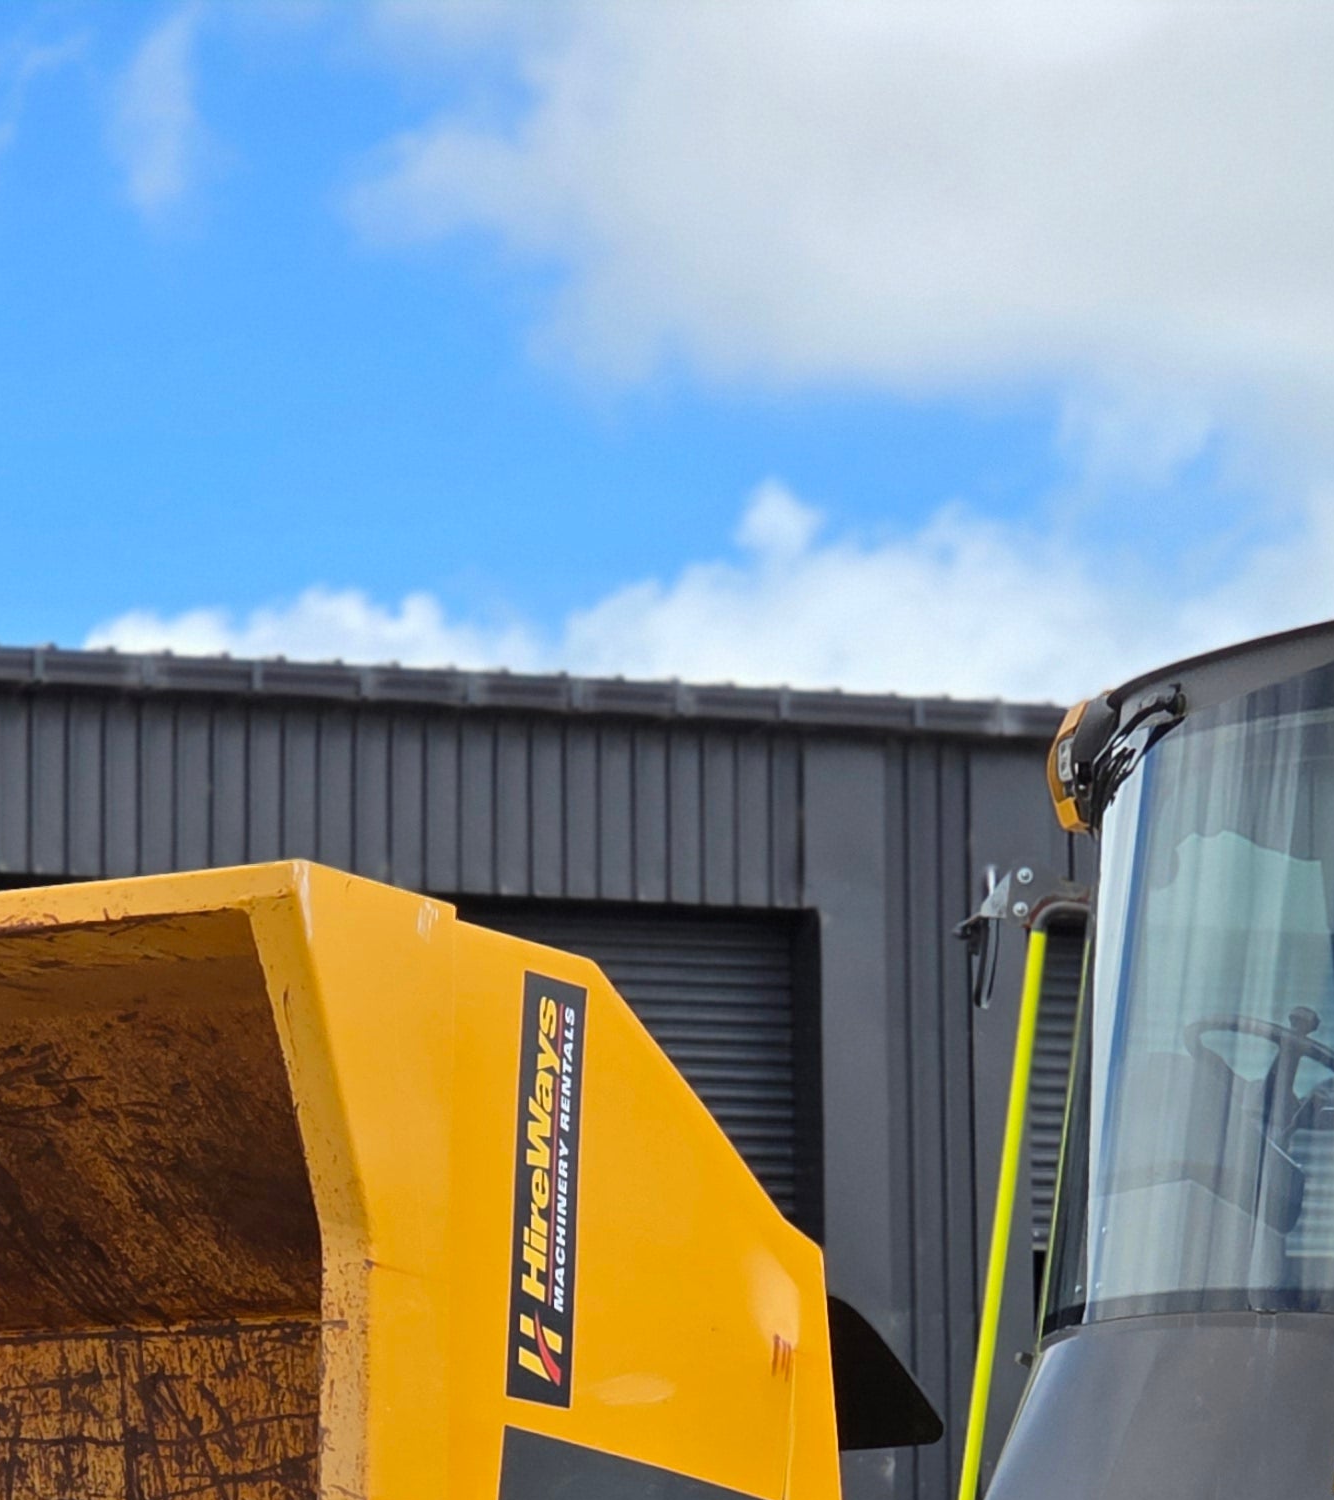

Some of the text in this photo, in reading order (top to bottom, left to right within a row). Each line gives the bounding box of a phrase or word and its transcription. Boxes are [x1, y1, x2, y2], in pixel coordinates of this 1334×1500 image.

[522, 997, 560, 1302] HireWays
[554, 1007, 575, 1312] MACHINERY RENTALS
